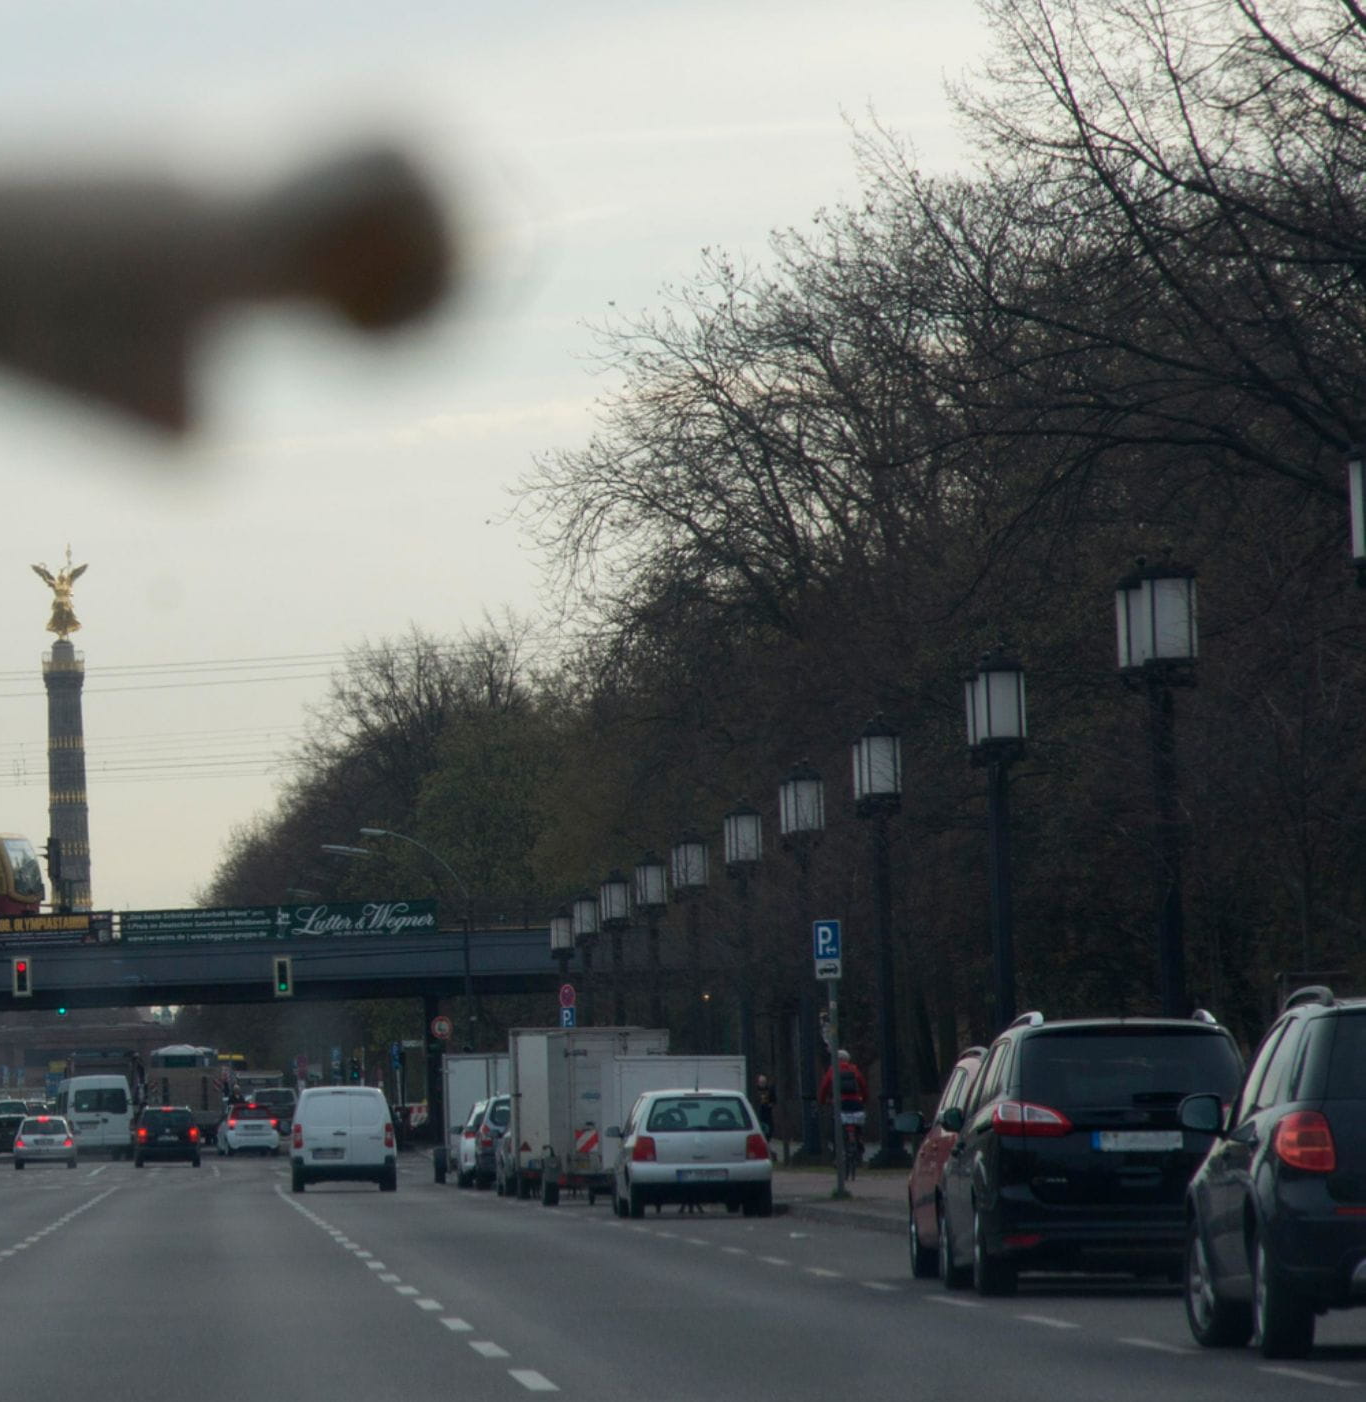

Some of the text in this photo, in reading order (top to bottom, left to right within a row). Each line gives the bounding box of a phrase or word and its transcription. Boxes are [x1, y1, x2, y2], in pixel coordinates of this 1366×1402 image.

[291, 902, 434, 935] Lutter & Wegner
[818, 926, 832, 956] P
[563, 1009, 572, 1028] P
